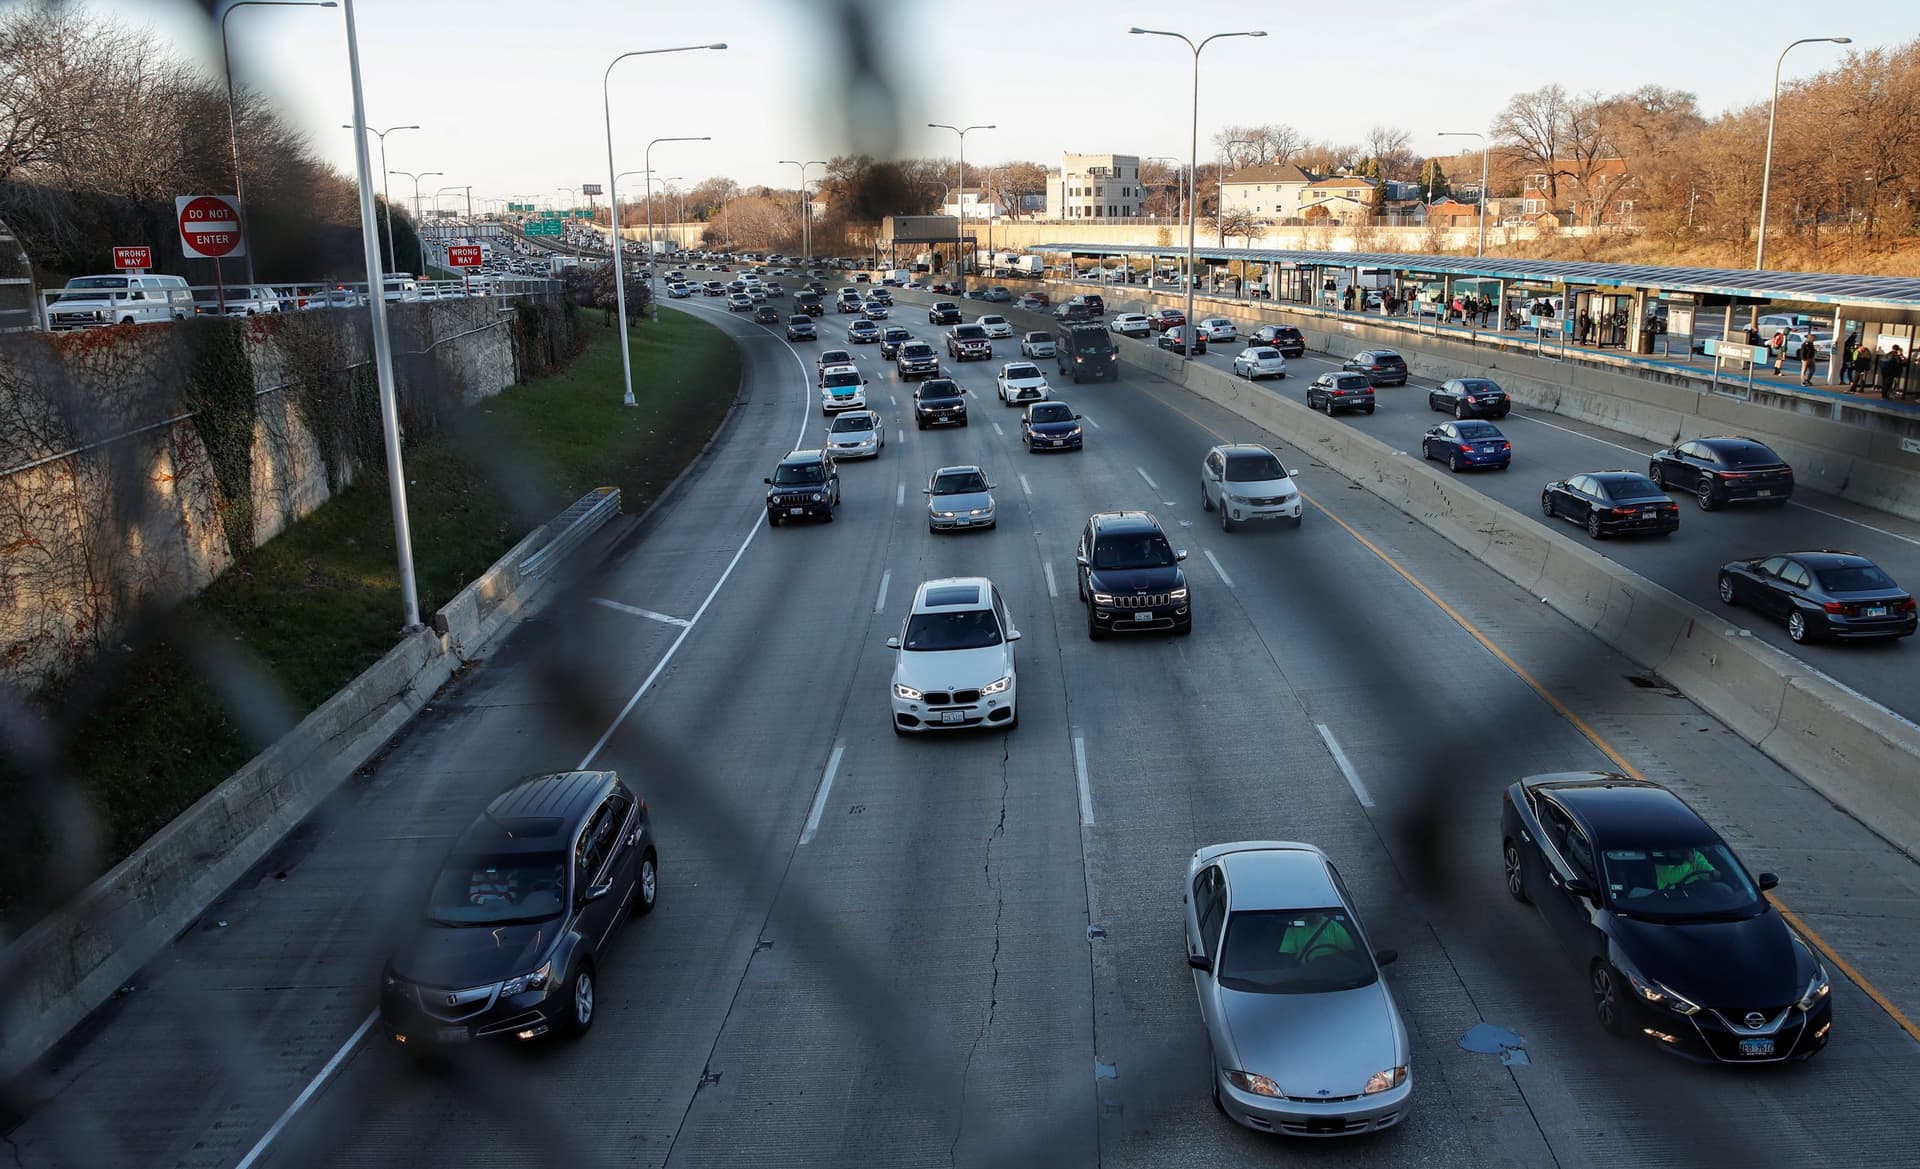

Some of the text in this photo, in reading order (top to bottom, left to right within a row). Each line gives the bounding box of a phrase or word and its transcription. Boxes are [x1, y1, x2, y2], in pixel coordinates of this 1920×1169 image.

[189, 209, 229, 219] DO NOT
[196, 235, 229, 244] ENTER
[452, 248, 478, 256] WRONG
